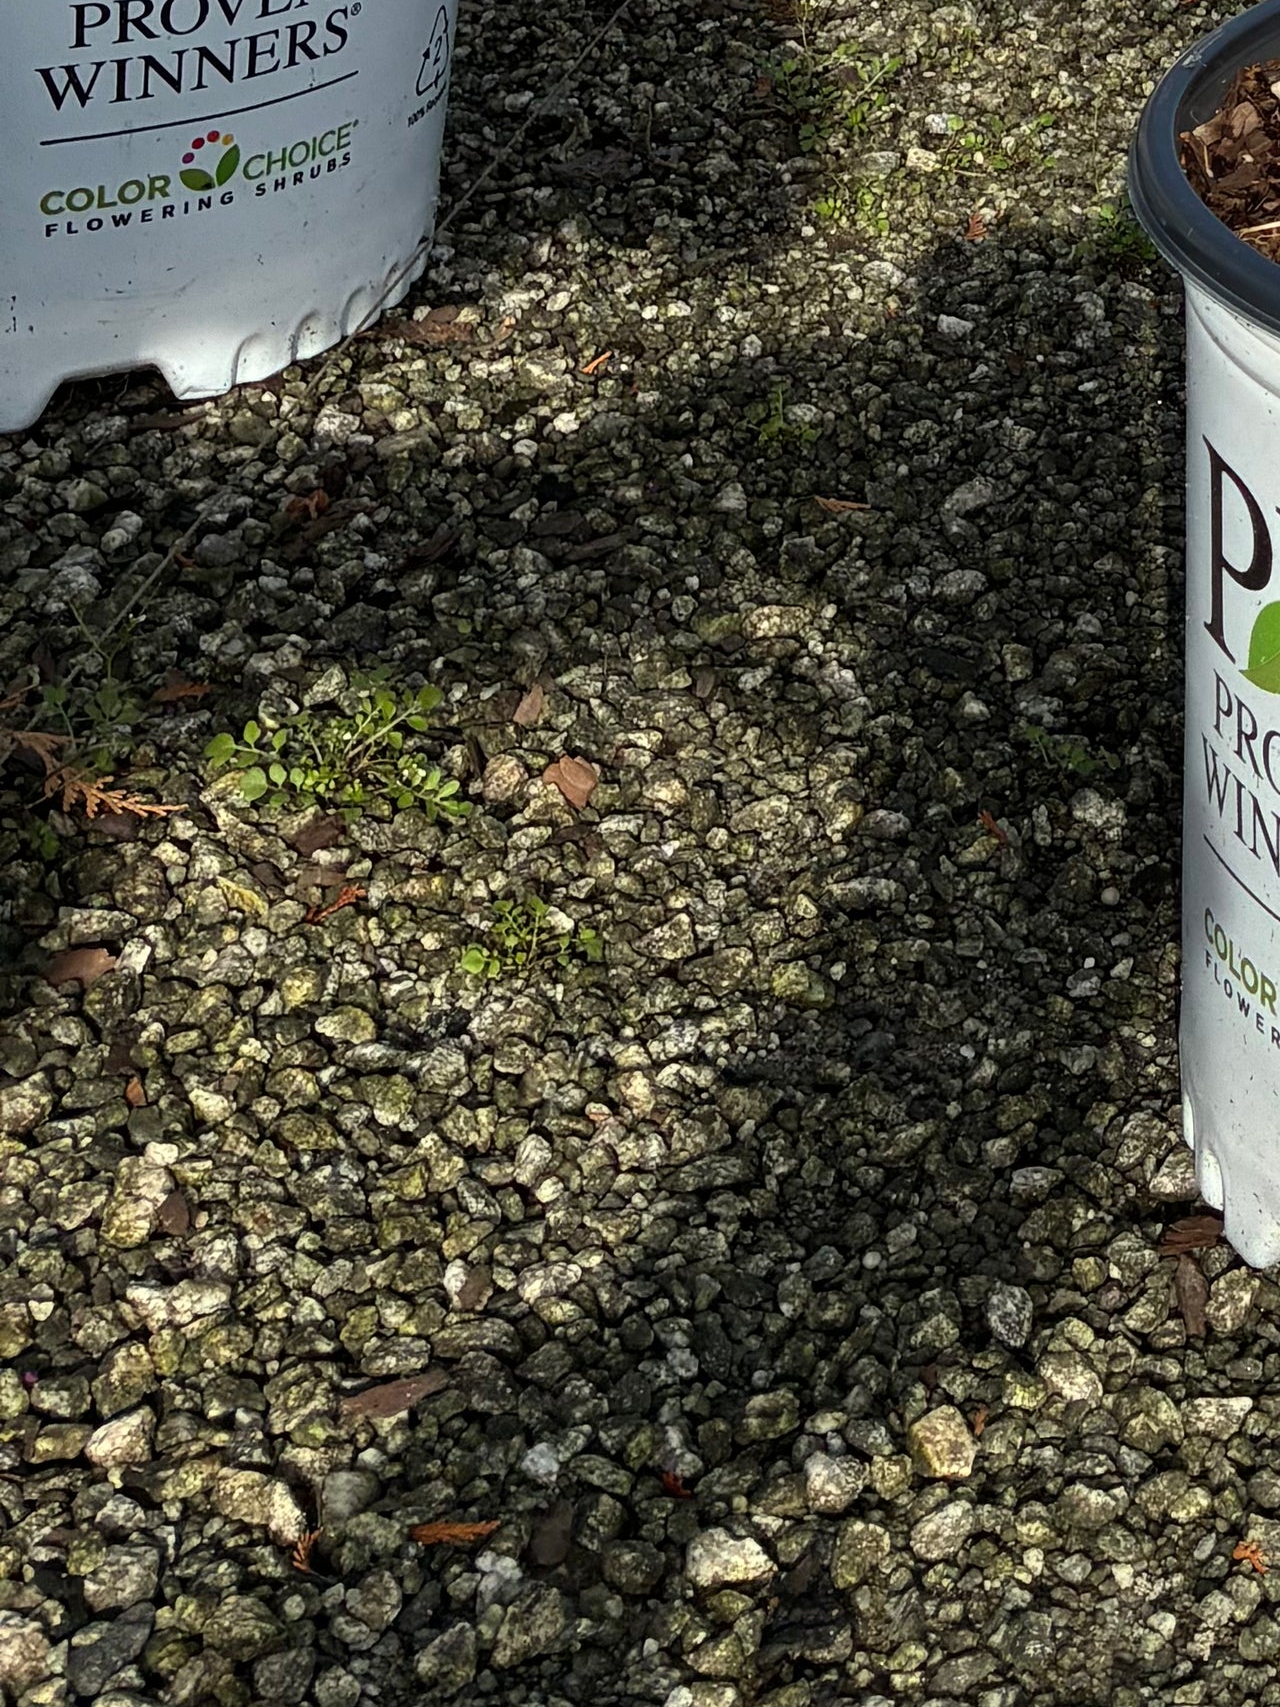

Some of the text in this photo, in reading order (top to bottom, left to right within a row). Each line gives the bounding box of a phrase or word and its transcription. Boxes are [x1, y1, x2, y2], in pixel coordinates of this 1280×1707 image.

[433, 34, 443, 67] 2
[39, 174, 170, 216] COLOR
[45, 151, 353, 238] FLOWERING SHRUBS
[1204, 907, 1277, 1016] COLOR
